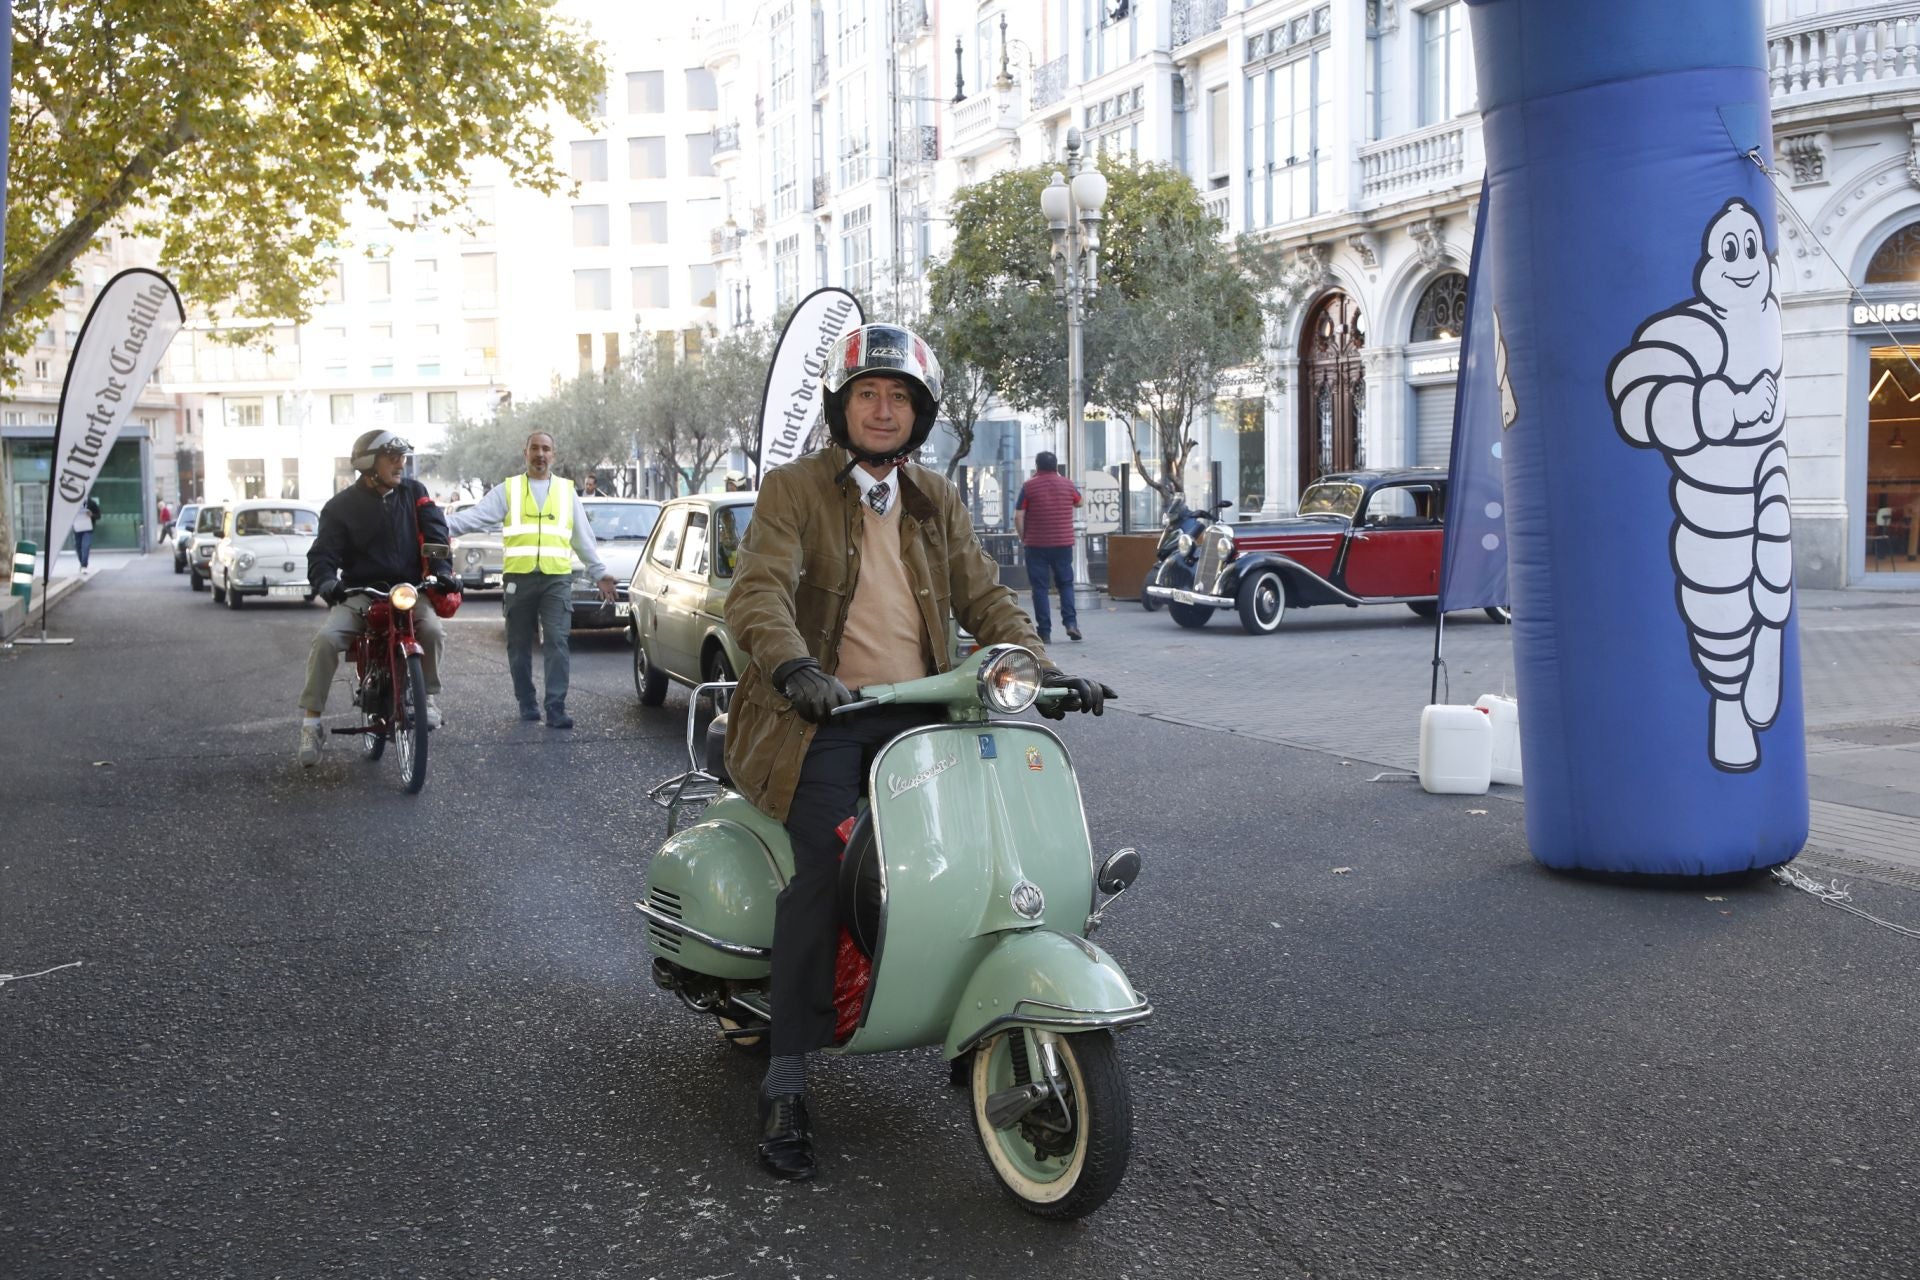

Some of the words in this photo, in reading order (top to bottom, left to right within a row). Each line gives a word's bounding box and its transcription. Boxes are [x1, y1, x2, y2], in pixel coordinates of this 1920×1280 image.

[108, 283, 169, 376] Castilla
[1853, 303, 1920, 325] BURG
[803, 299, 854, 378] Castilla
[95, 376, 126, 404] de
[791, 375, 818, 403] de
[67, 403, 115, 468] Norte
[768, 402, 808, 459] Norte
[58, 468, 90, 504] El
[1086, 489, 1120, 504] RGER
